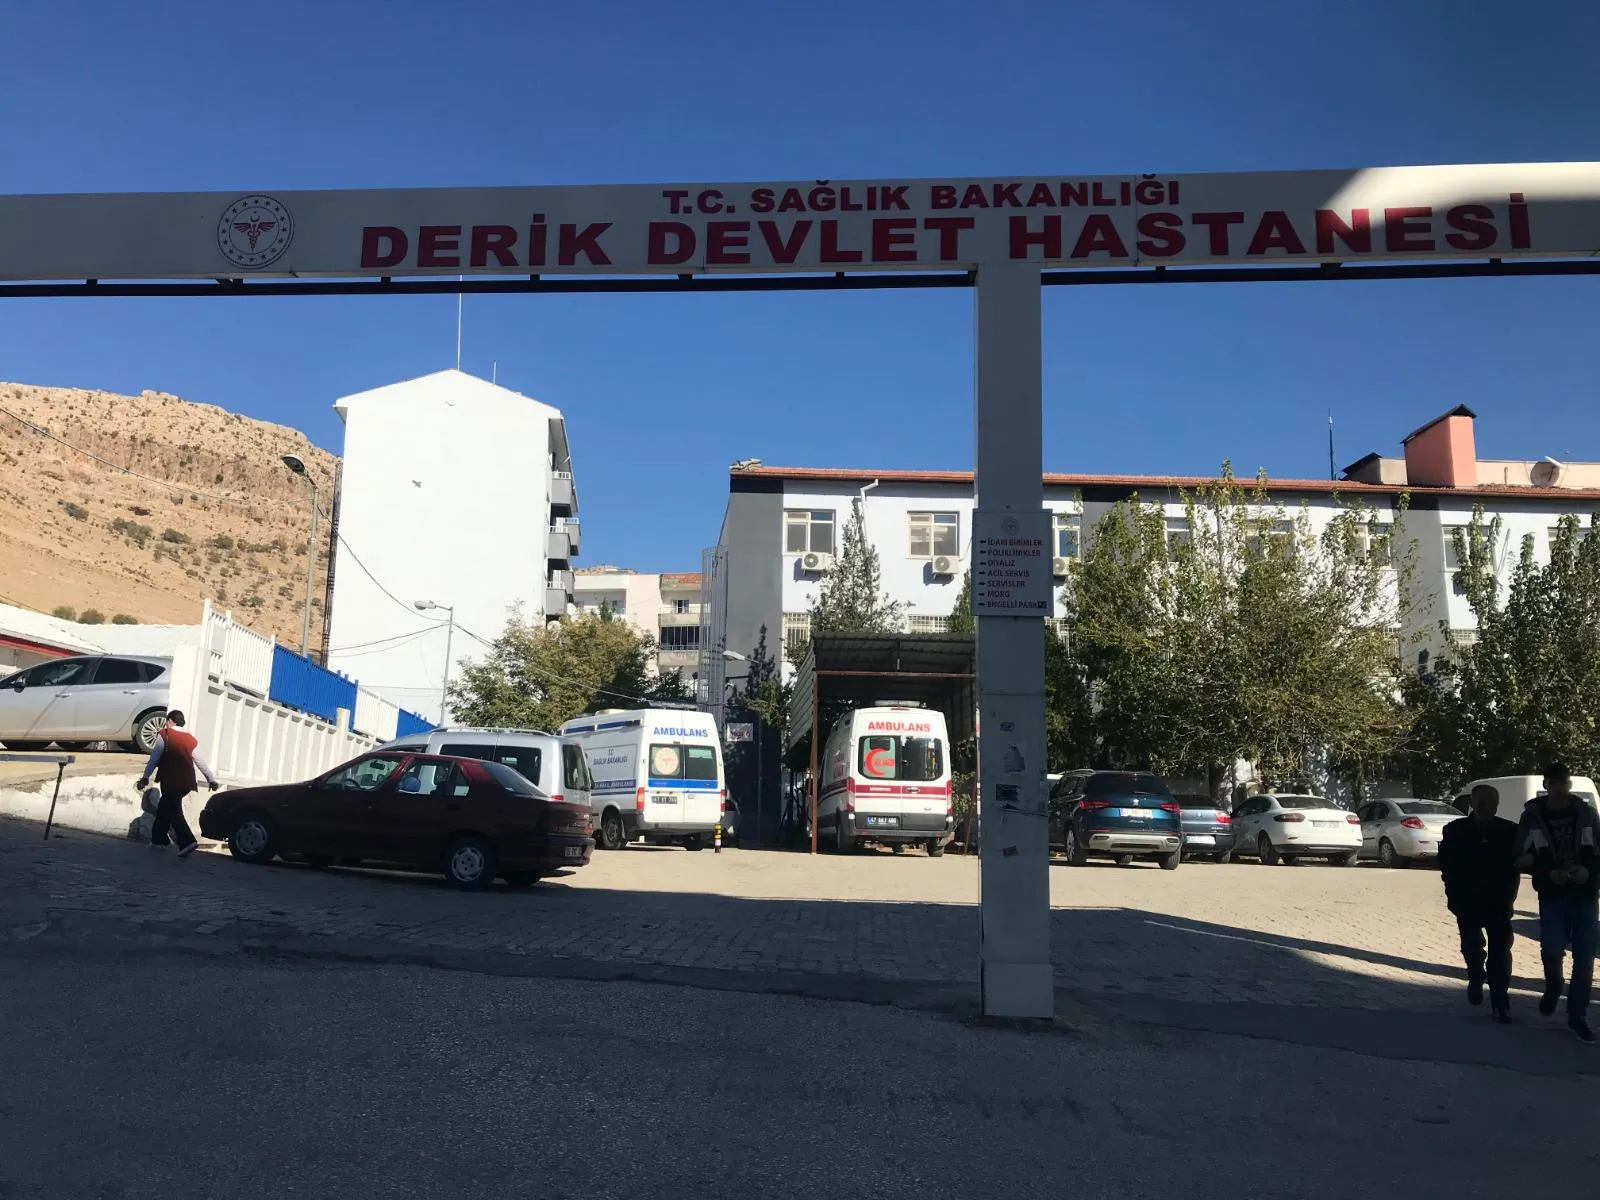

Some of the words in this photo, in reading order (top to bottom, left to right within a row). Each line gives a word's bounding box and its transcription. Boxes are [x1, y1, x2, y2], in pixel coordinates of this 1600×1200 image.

[662, 188, 736, 215] T.C.
[749, 179, 909, 214] SAĞLIK
[930, 173, 1180, 211] BAKANLIĞI
[360, 213, 614, 269] DERİK
[647, 217, 975, 266] DEVLET
[1008, 192, 1532, 260] HASTANESİ
[987, 569, 1002, 577] ACİL
[1005, 569, 1030, 577] SERVİS
[987, 579, 1026, 588] SERVİSLER
[987, 590, 1011, 598] MORG
[868, 721, 931, 732] AMBULANS
[653, 727, 708, 738] AMBULANS
